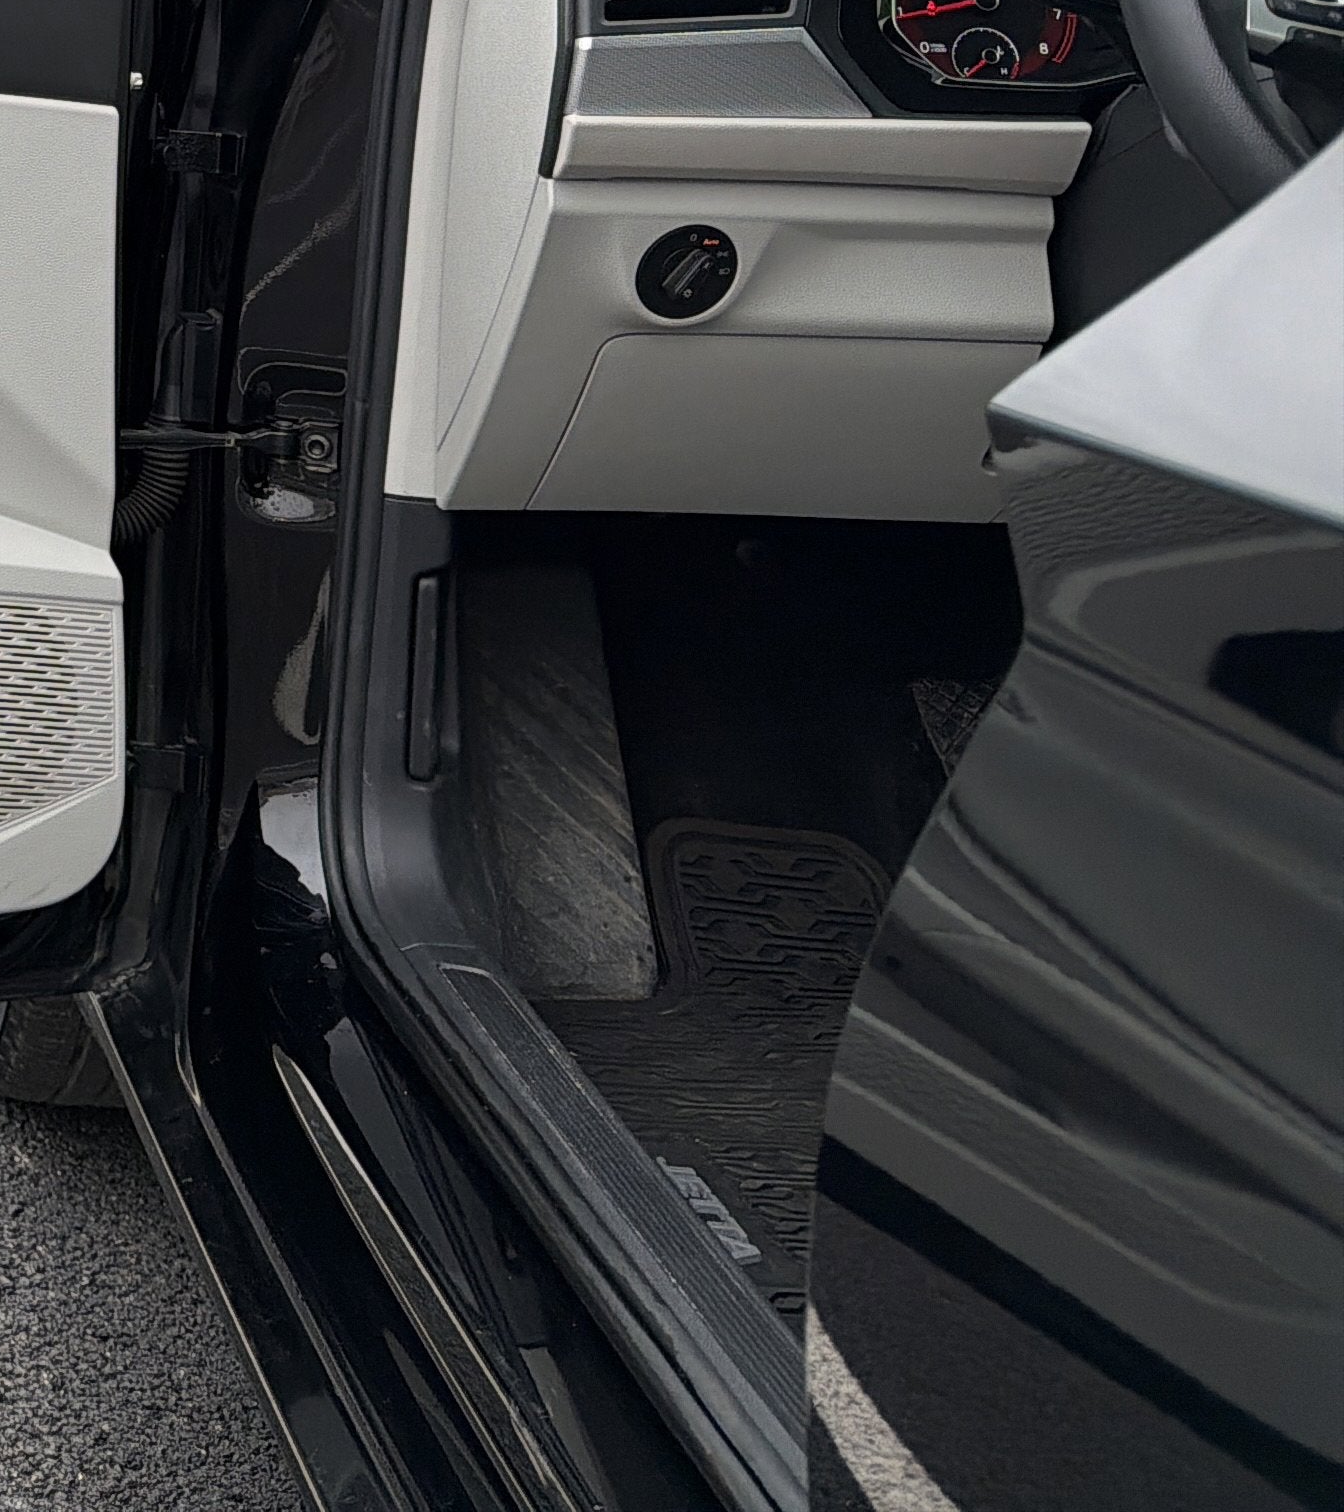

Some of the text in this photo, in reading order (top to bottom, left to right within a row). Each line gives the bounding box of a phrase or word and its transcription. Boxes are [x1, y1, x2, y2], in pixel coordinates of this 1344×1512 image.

[1053, 8, 1061, 19] 7
[919, 41, 930, 54] 0
[1039, 43, 1048, 54] 8
[655, 1156, 762, 1266] JETTA
